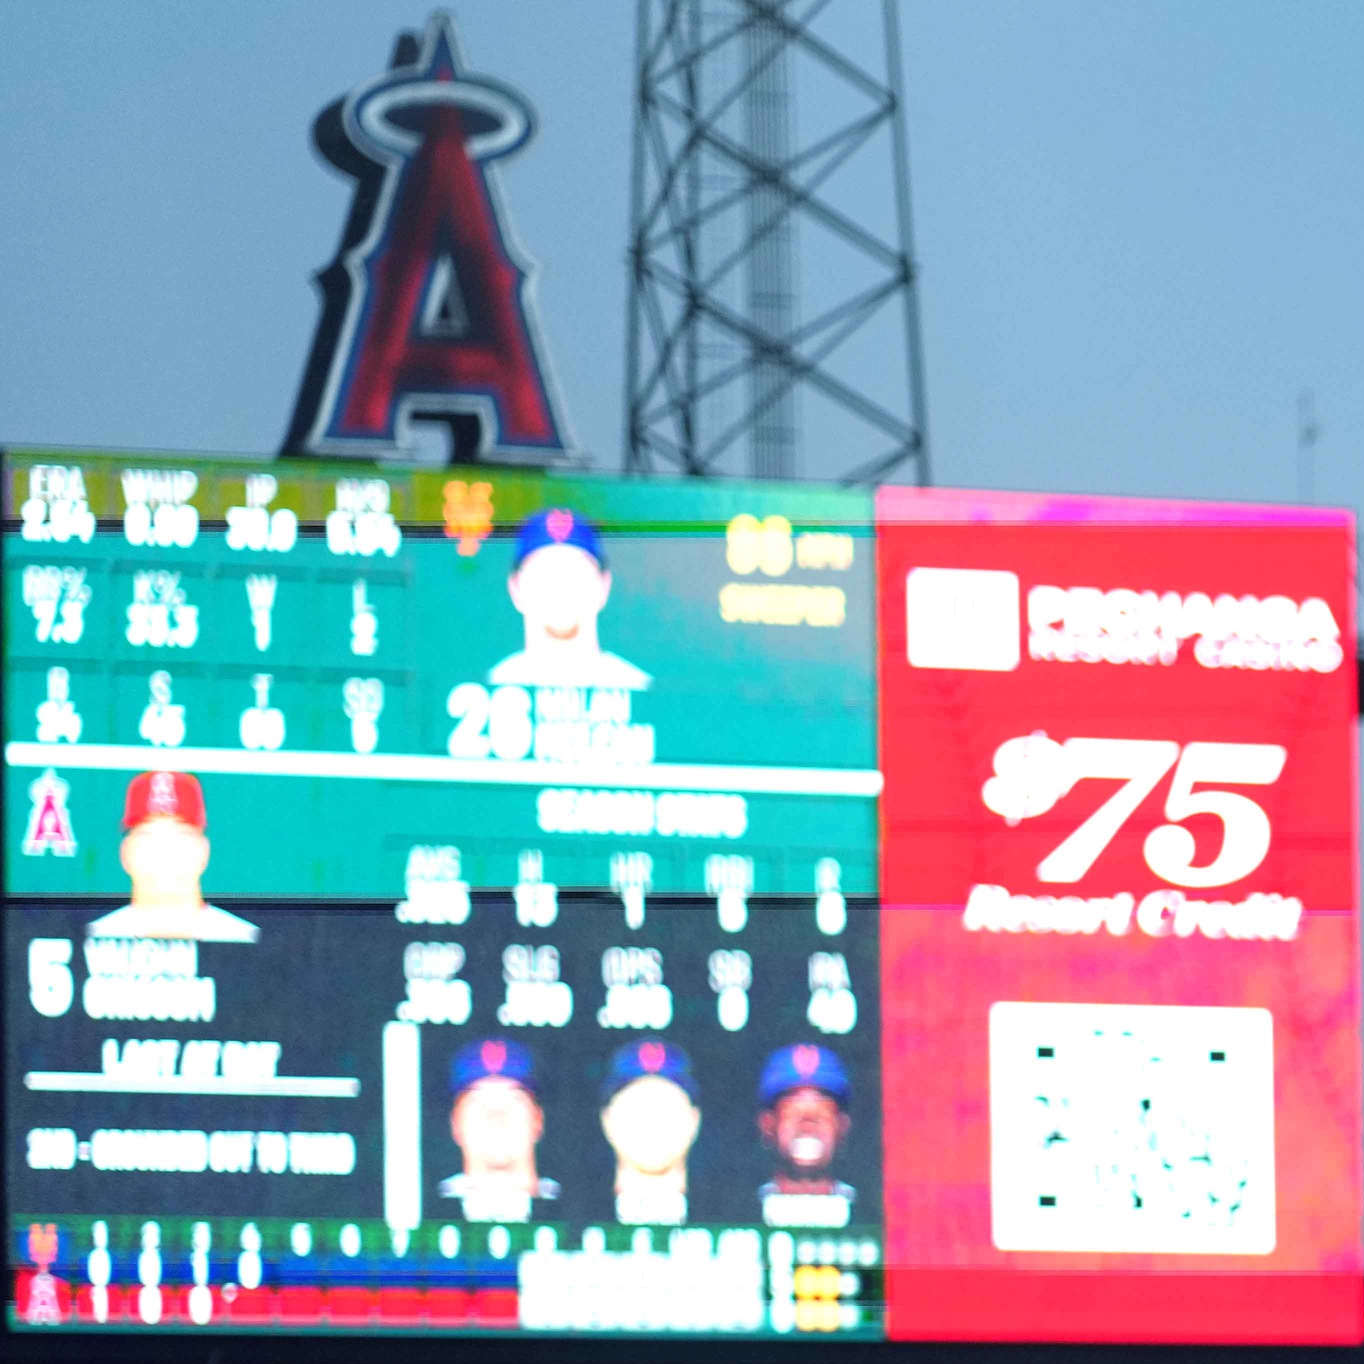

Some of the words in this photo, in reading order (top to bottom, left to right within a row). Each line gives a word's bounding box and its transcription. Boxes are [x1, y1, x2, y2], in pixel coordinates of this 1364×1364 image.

[303, 8, 595, 468] A
[449, 684, 531, 761] 26
[981, 731, 1288, 888] $75
[30, 939, 72, 1015] 5
